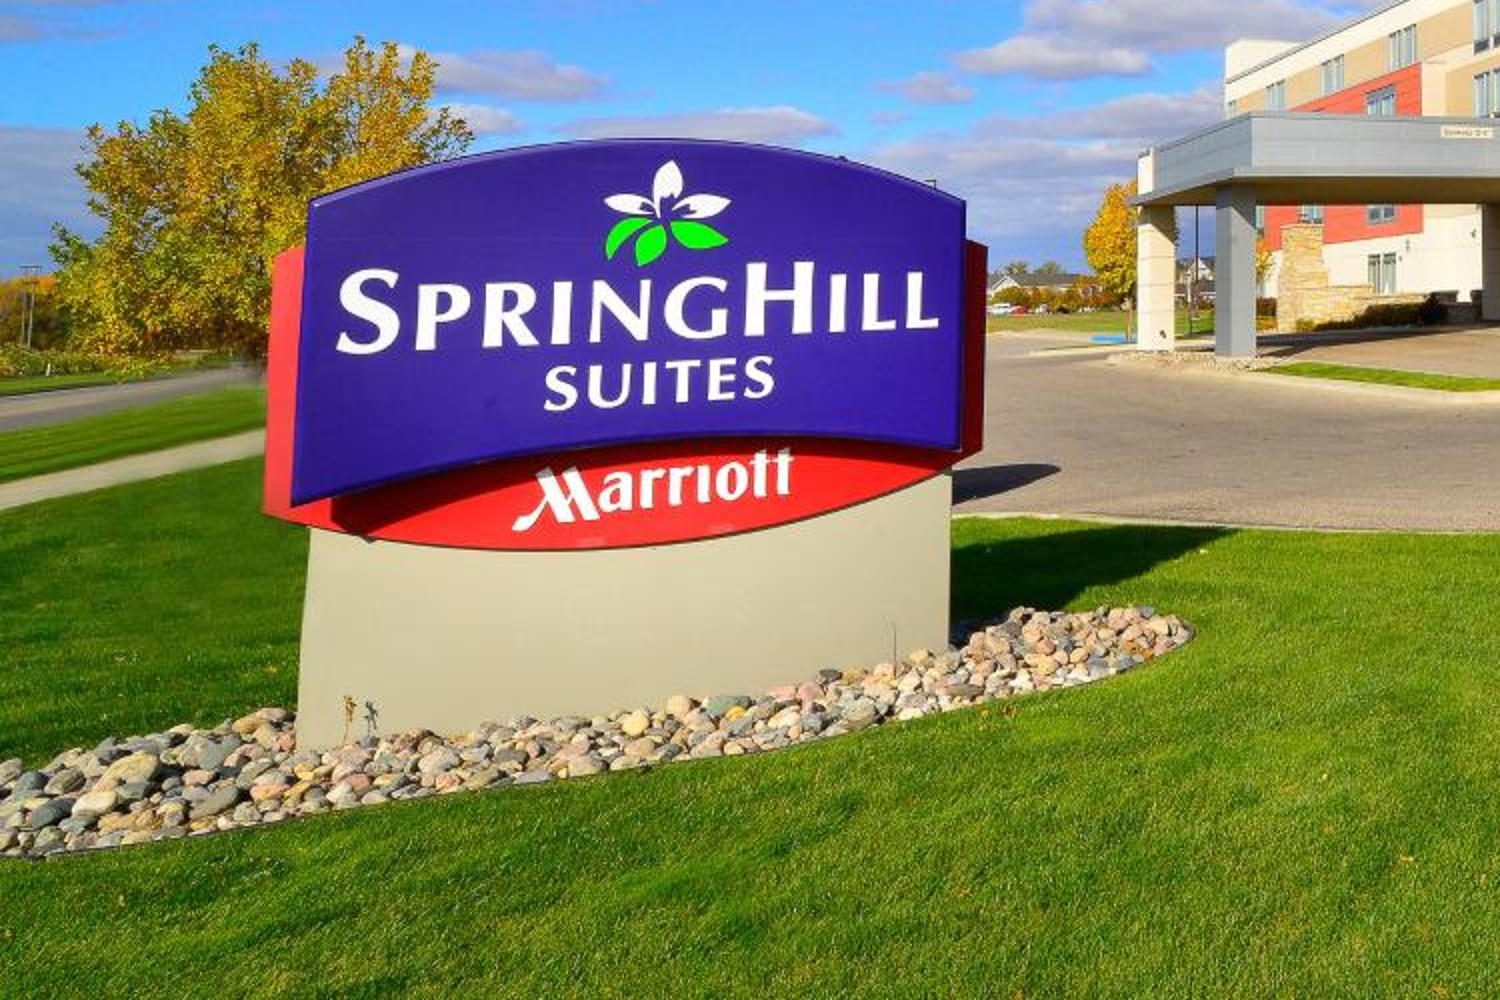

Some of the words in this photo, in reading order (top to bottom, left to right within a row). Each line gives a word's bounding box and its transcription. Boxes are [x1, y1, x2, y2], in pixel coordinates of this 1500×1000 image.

[335, 261, 940, 355] SPRINGHILL
[543, 355, 776, 412] SUITES
[511, 447, 795, 532] Marriott
